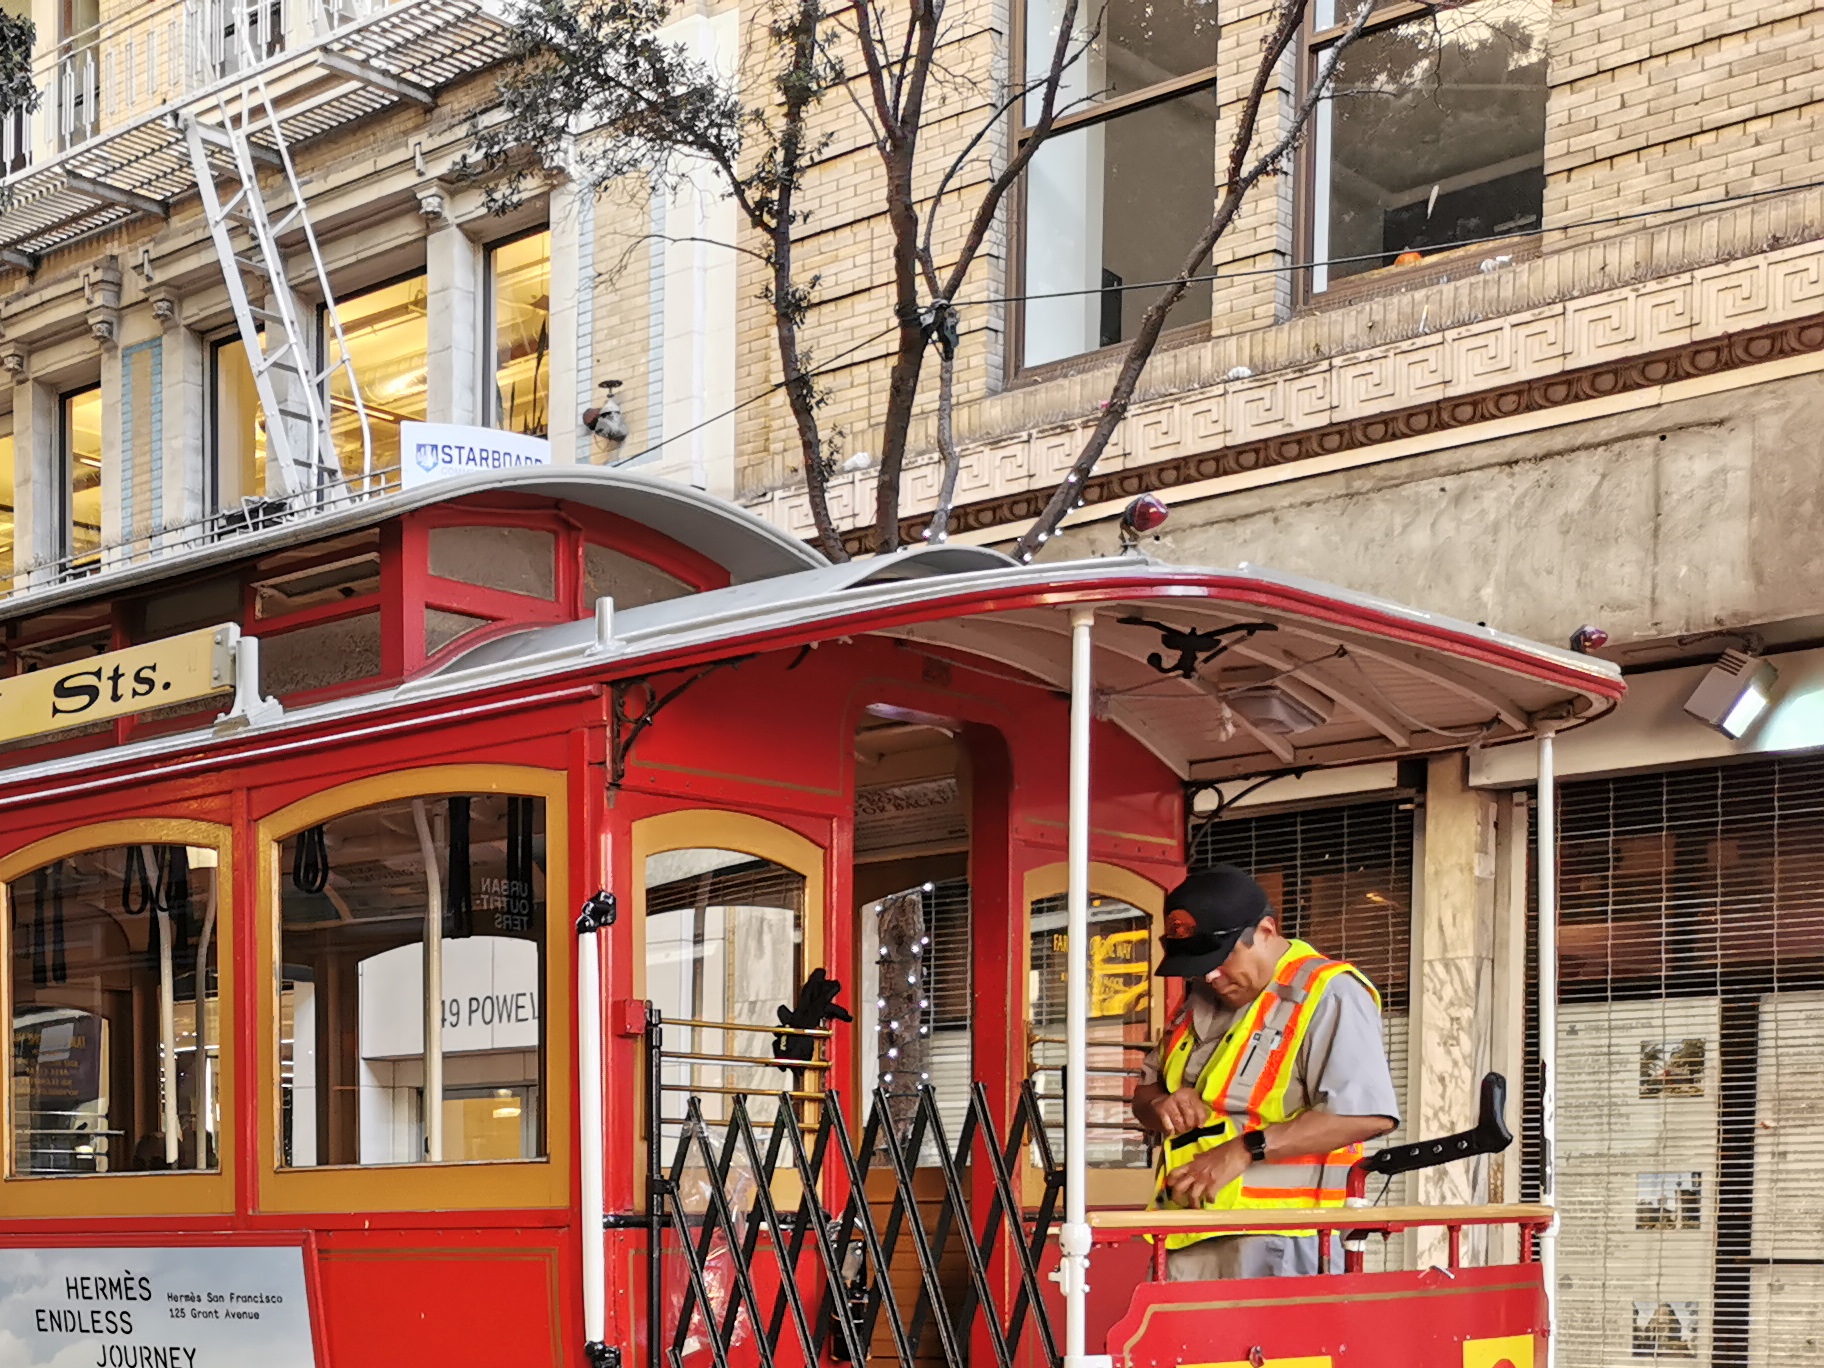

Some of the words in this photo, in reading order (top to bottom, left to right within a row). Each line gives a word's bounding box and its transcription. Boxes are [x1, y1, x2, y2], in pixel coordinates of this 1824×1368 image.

[50, 658, 173, 719] Sts.
[65, 1270, 152, 1302] HERMÈS
[207, 1291, 225, 1303] San
[229, 1292, 283, 1304] Francisco
[36, 1308, 133, 1335] ENDLESS
[169, 1307, 186, 1318] 125
[190, 1307, 220, 1319] Grant
[225, 1308, 260, 1320] Avenue
